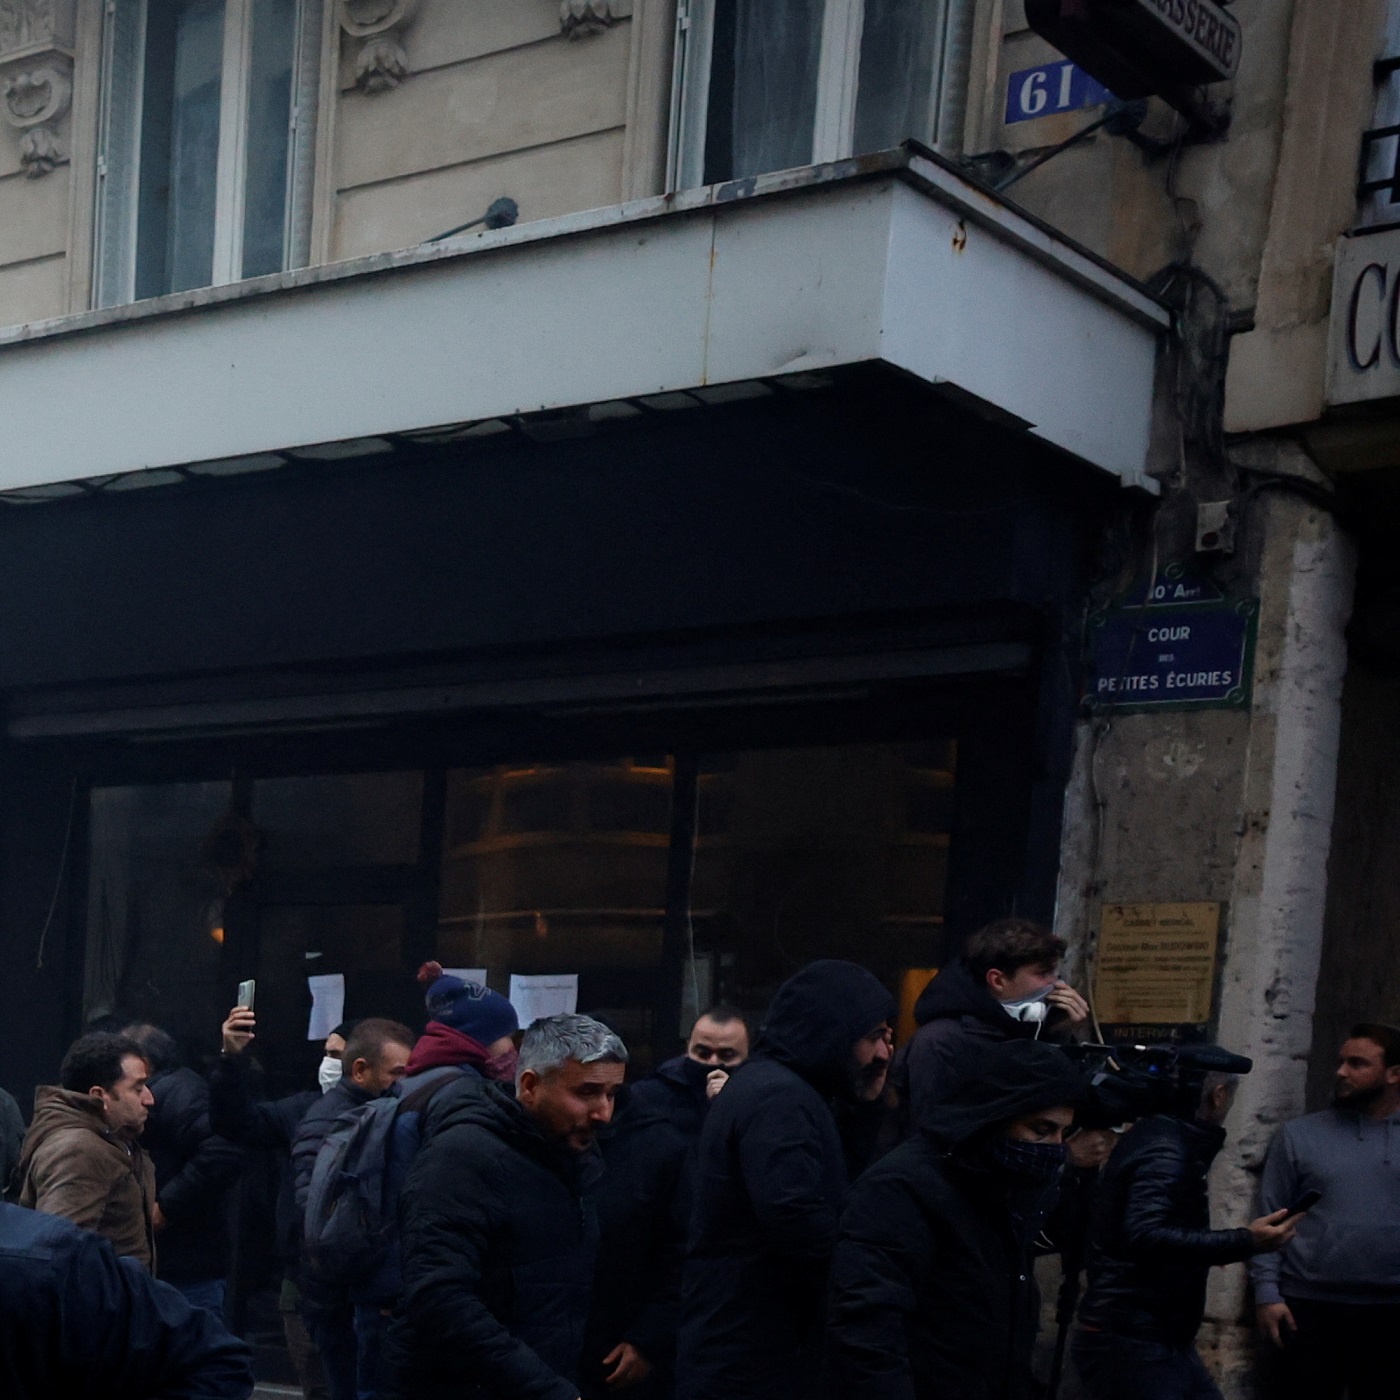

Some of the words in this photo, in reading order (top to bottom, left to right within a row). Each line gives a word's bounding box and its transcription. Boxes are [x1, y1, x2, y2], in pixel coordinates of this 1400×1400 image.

[1019, 63, 1075, 115] 61
[1147, 625, 1191, 643] COUR
[1166, 670, 1232, 689] ÉCURIES
